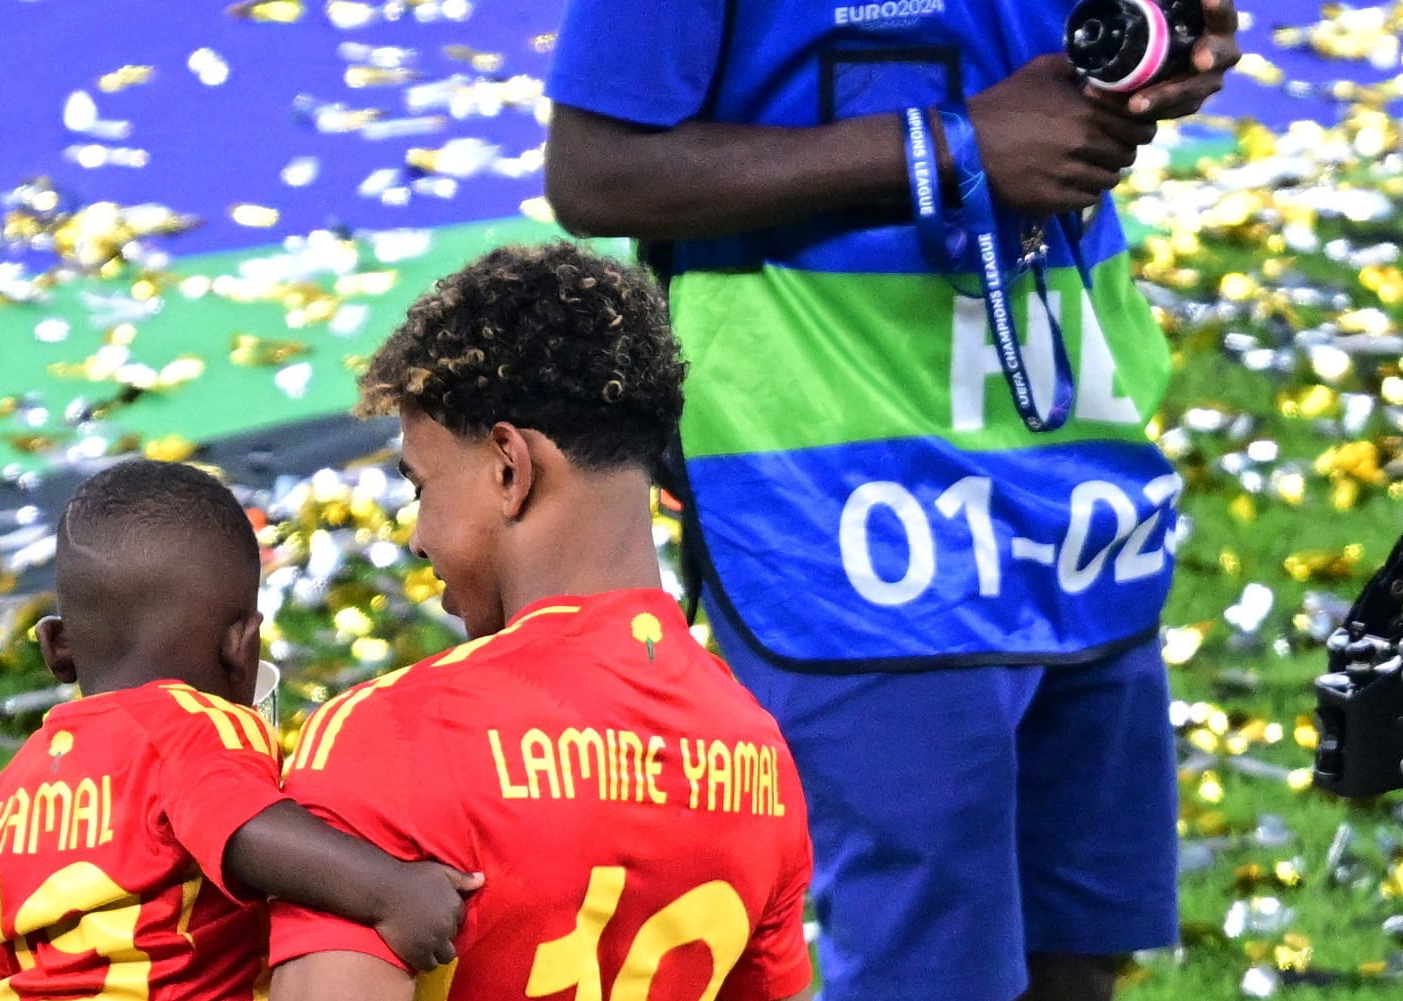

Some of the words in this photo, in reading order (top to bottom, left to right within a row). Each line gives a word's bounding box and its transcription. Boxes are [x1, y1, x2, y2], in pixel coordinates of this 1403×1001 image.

[914, 161, 935, 216] LEAGUE
[978, 232, 1001, 287] LEAGUE
[989, 289, 1018, 372] CHAMPIONS
[1012, 371, 1029, 406] UEFA
[839, 473, 1183, 607] 01-02
[487, 727, 668, 805] LAMINE
[679, 737, 786, 817] YAMAL
